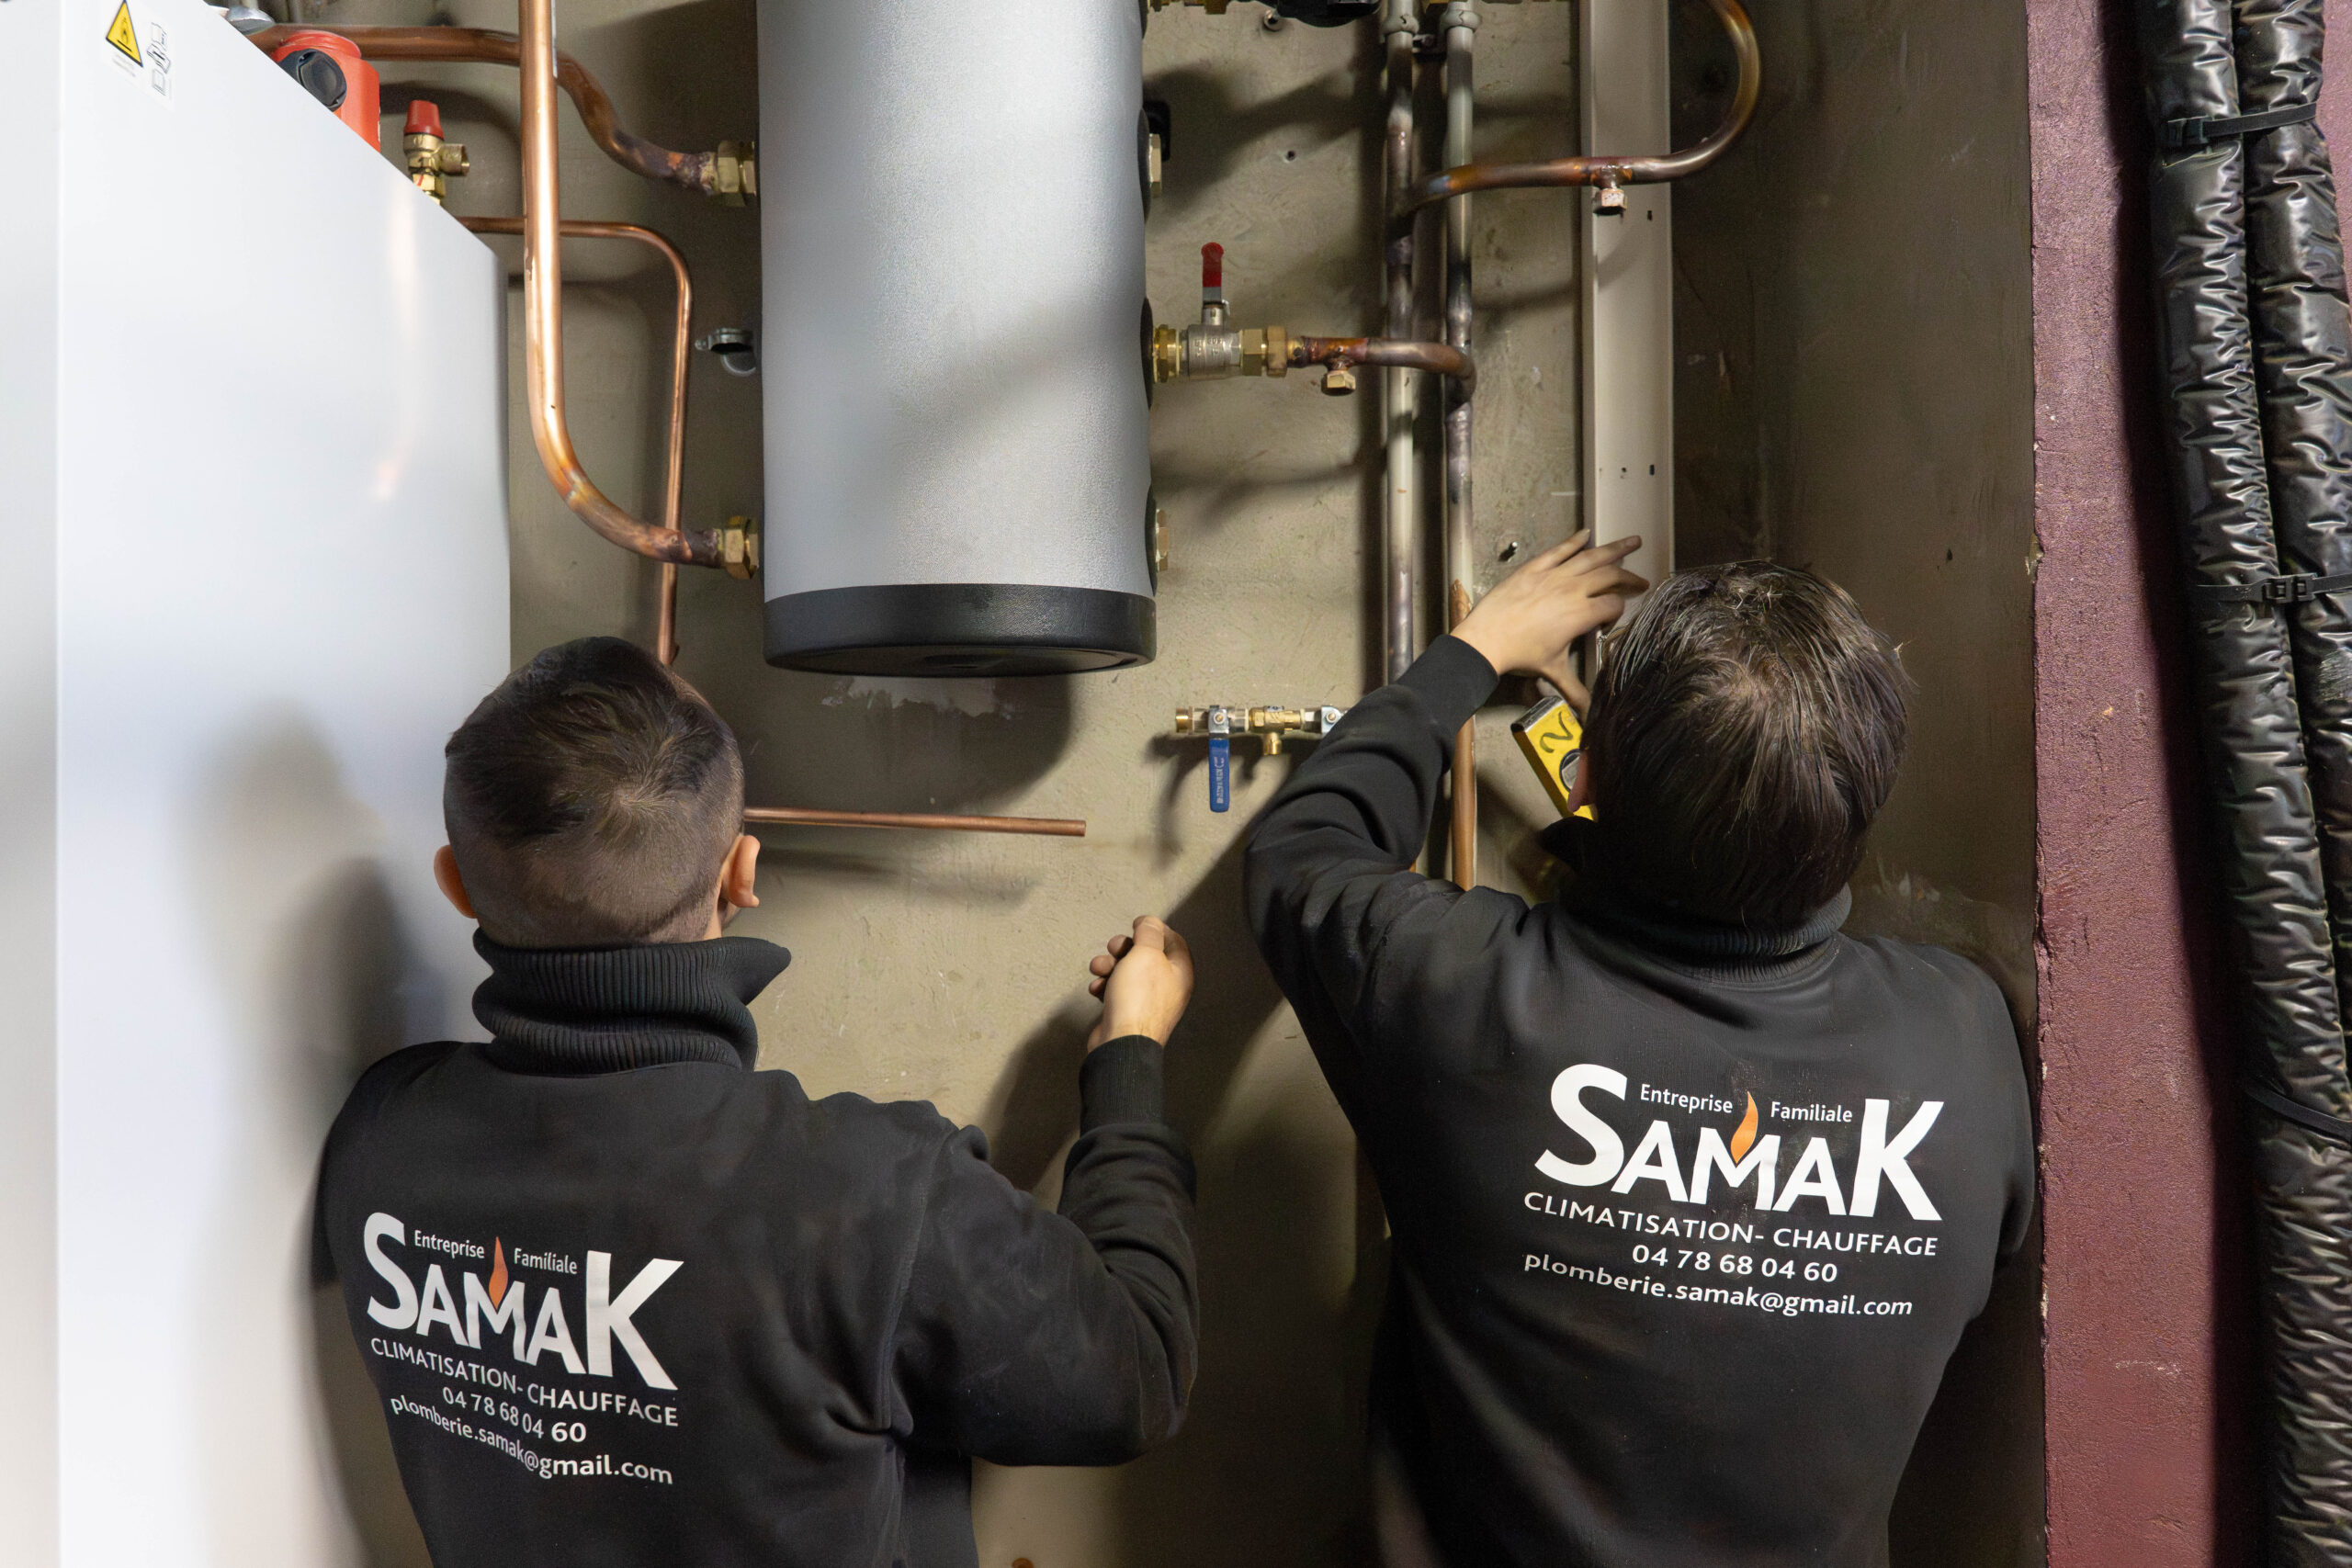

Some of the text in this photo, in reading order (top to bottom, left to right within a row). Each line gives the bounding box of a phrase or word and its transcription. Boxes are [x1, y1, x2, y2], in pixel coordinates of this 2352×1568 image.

[1641, 1084, 1852, 1122] Entreprise Familiale
[1534, 1064, 1944, 1221] SAMAK
[415, 1230, 577, 1274] Entreprise Familiale
[1633, 1245, 1838, 1282] 04 78 68 04 60
[1773, 1228, 1938, 1256] CHAUFFAGE
[364, 1213, 684, 1390] SAMAK
[1525, 1255, 1912, 1316] plomberie.samak@gmail.com
[443, 1387, 586, 1442] 04 78 68 04 60
[527, 1383, 678, 1426] CHAUFFAGE
[390, 1396, 672, 1484] plomberie.samak@gmail.com
